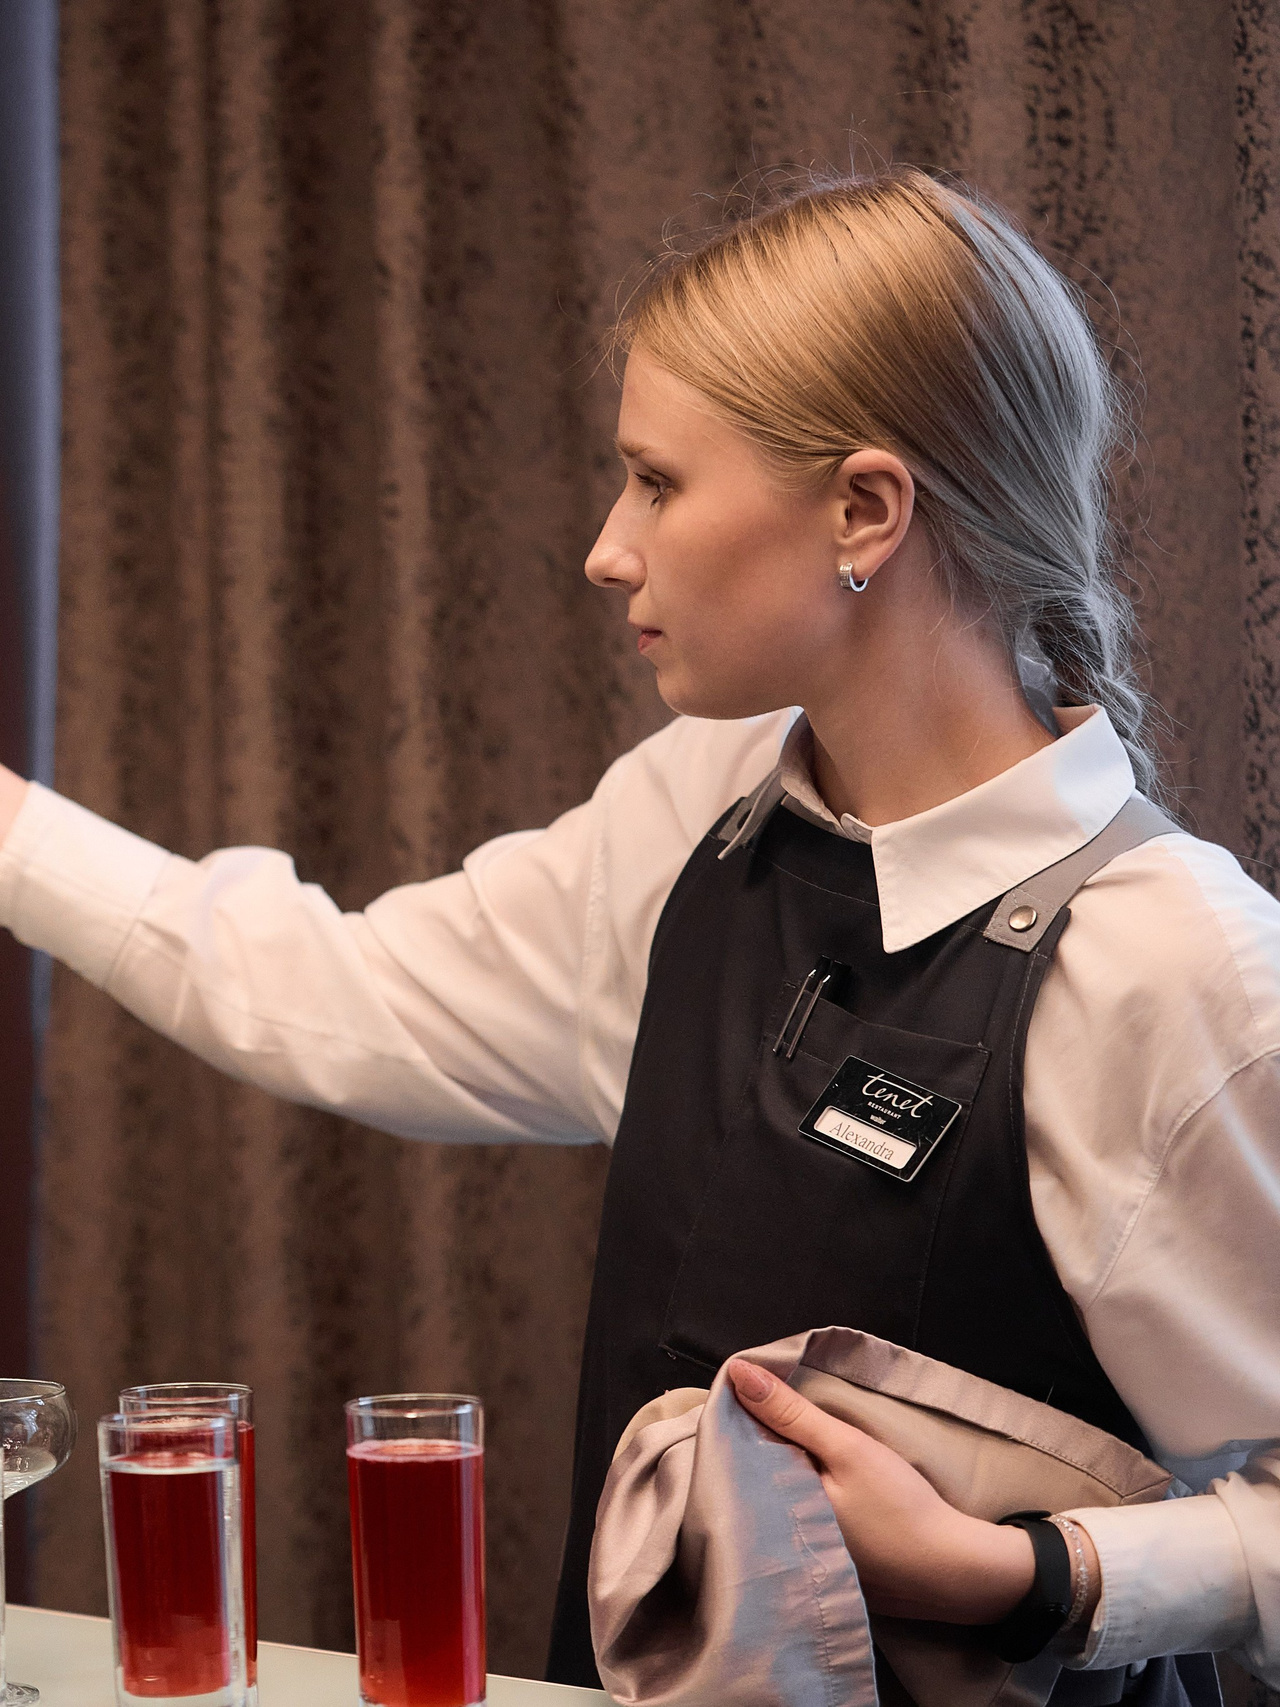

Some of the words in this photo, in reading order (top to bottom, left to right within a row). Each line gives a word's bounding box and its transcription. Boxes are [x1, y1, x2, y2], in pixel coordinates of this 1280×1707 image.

[862, 1073, 934, 1118] tenet
[867, 1101, 902, 1120] RESTAURANT
[829, 1121, 895, 1161] Alexandra
